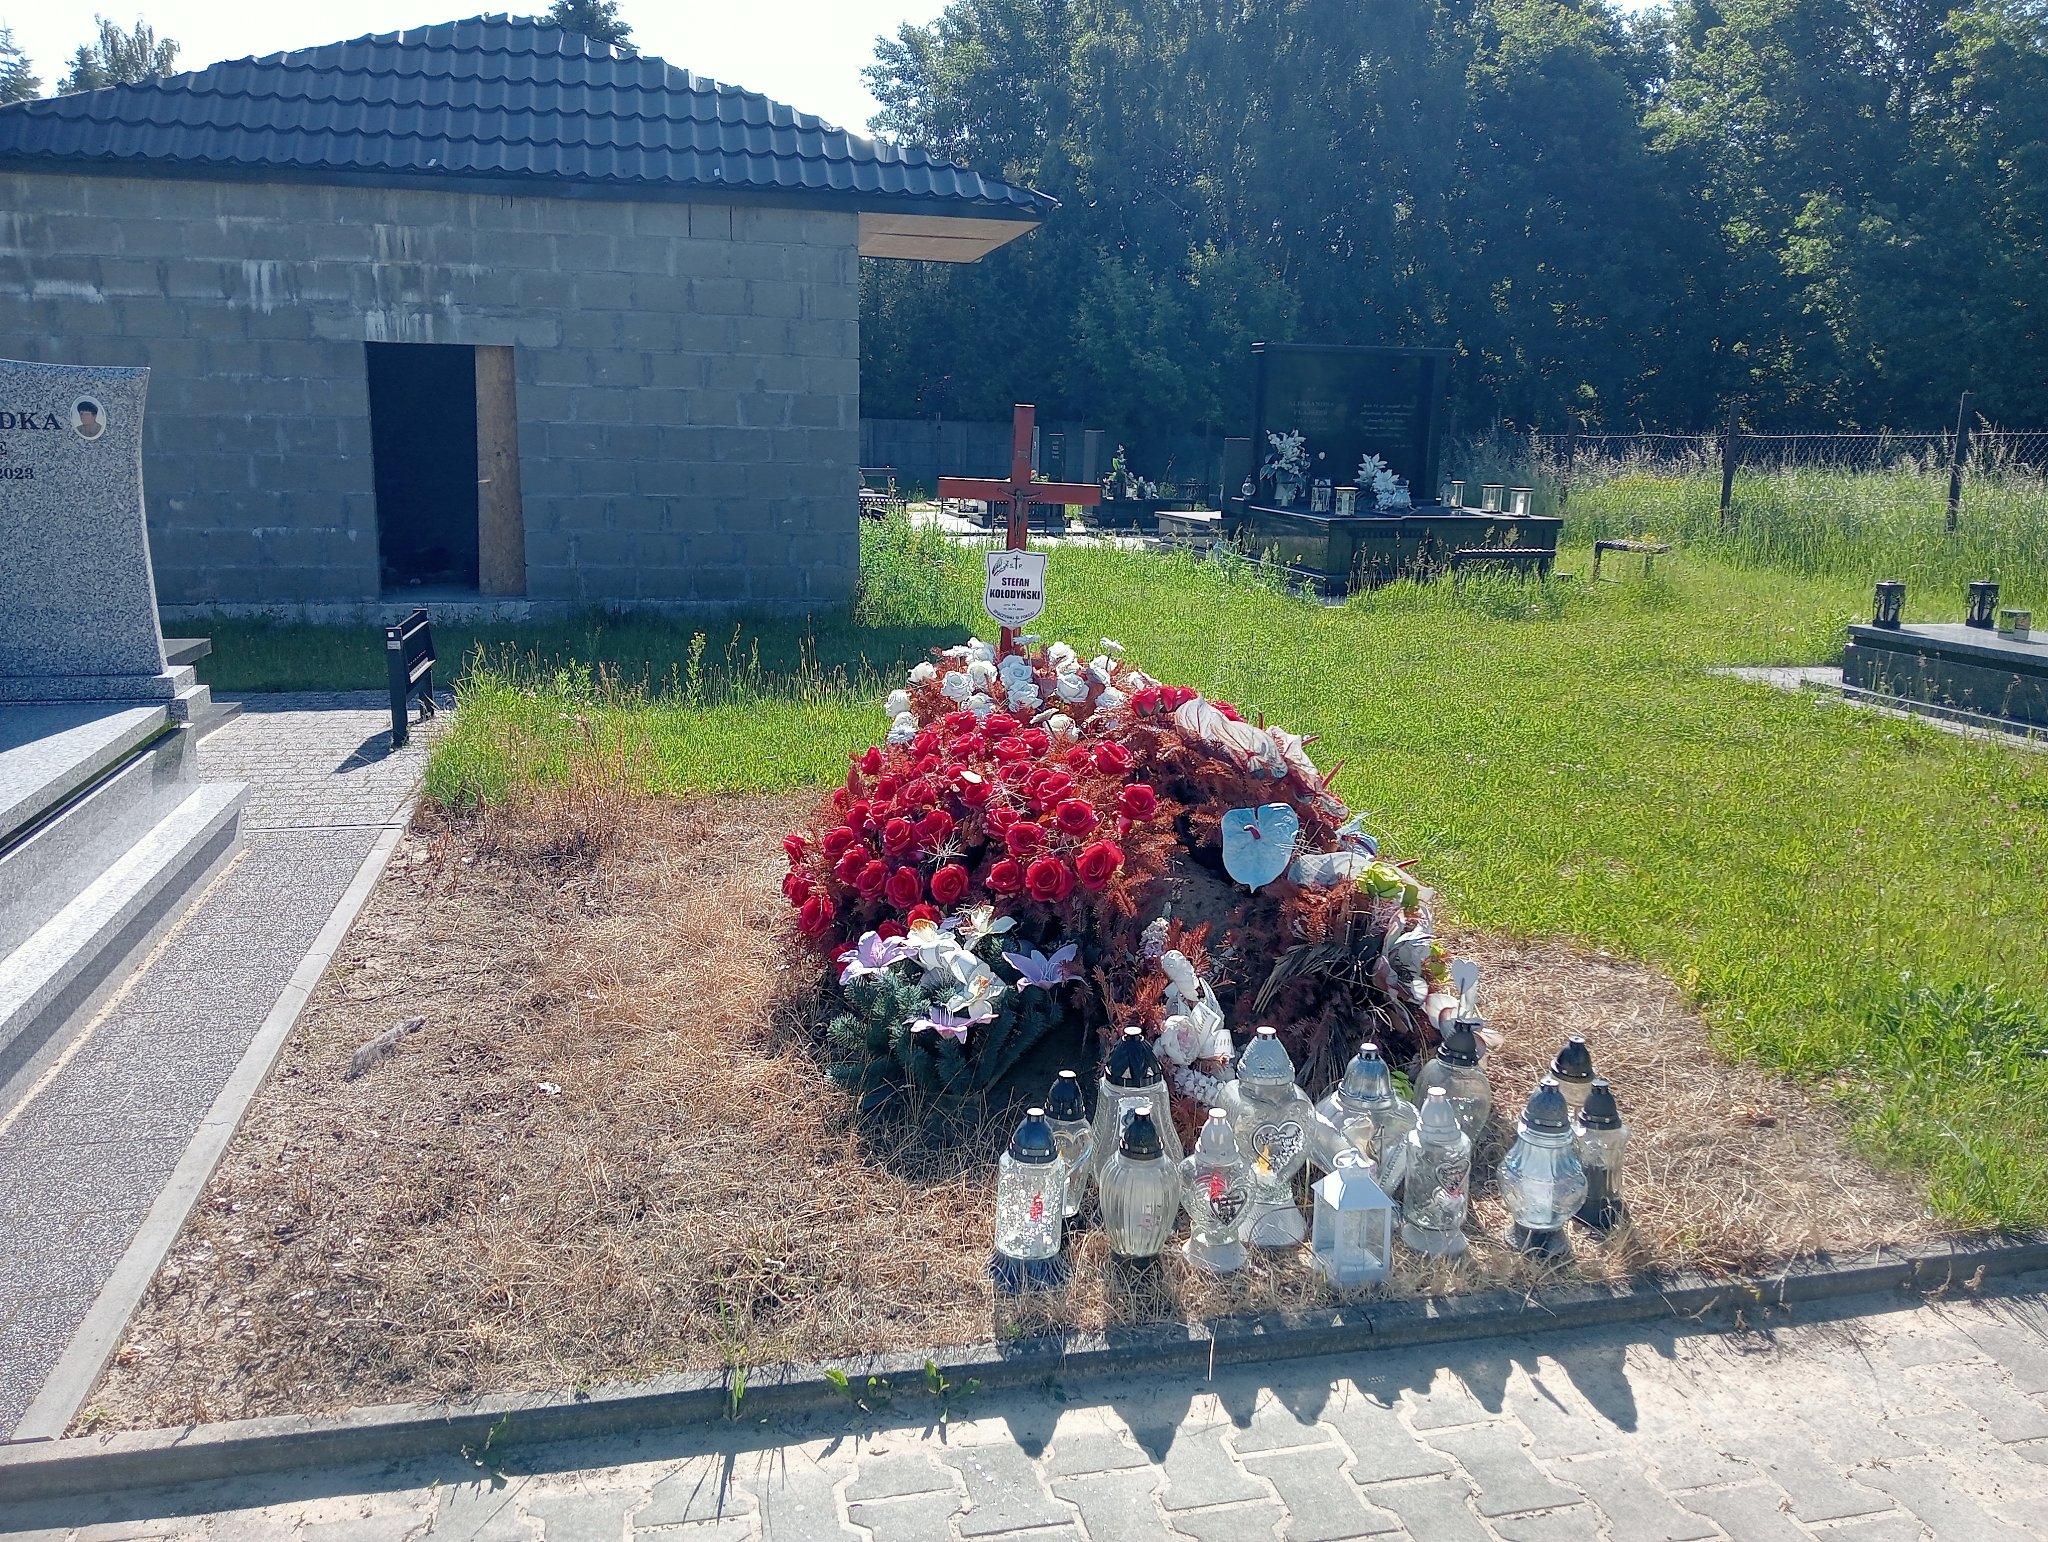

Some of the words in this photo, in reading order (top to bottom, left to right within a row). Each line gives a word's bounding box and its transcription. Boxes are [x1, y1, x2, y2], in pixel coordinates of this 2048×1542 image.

[0, 412, 62, 430] DKA
[1002, 577, 1030, 587] STEFAN
[989, 588, 1041, 600] KOŁODYŃSKI
